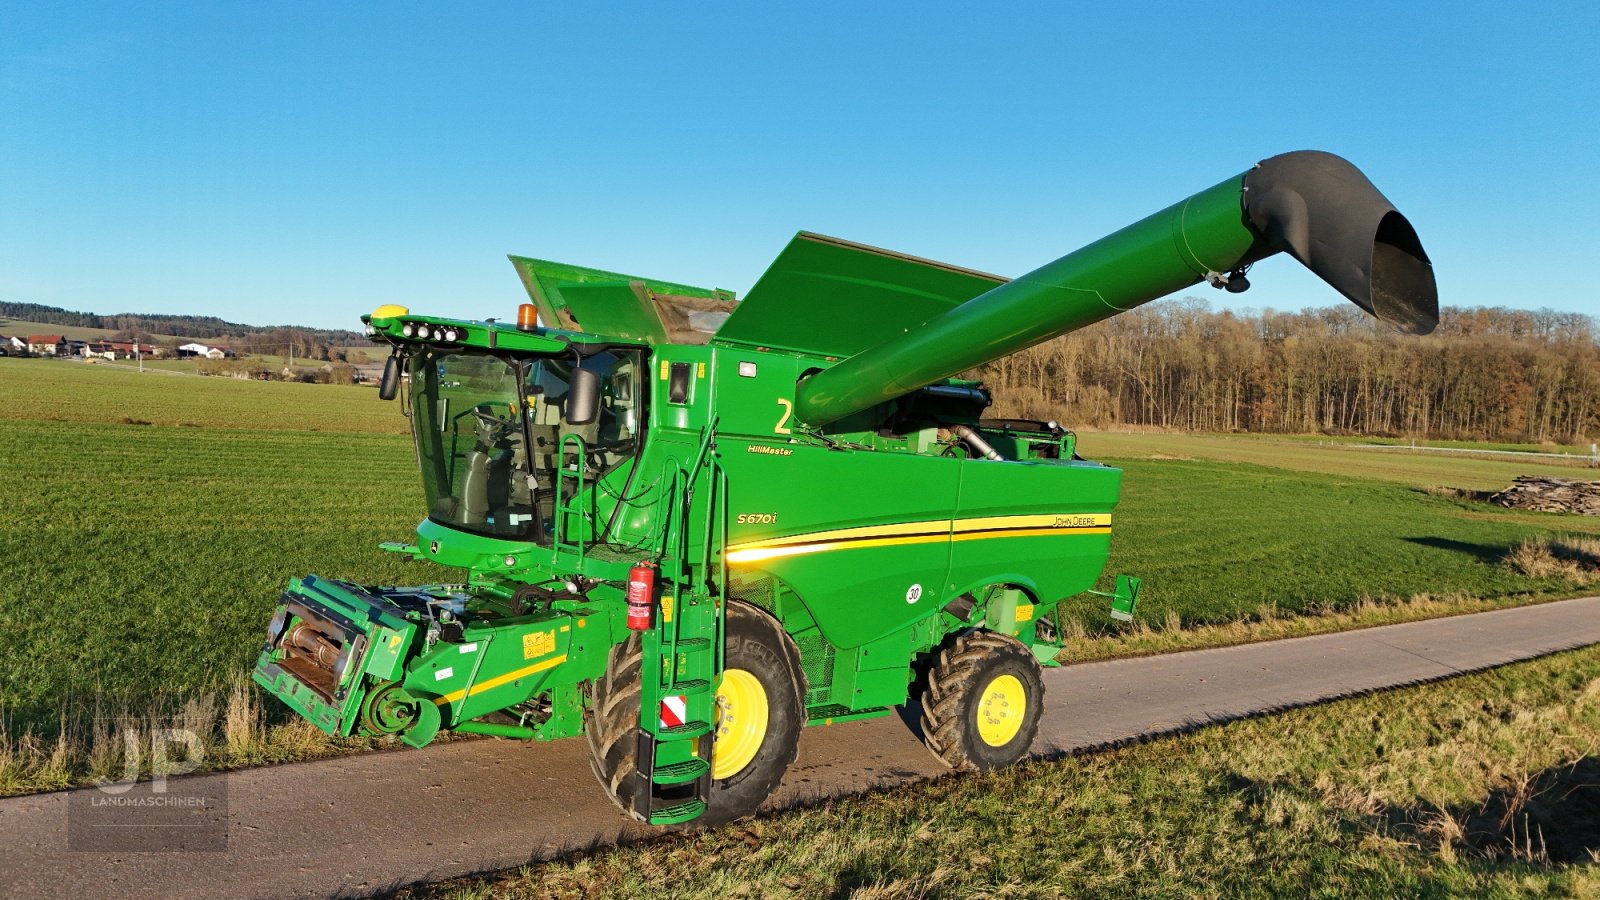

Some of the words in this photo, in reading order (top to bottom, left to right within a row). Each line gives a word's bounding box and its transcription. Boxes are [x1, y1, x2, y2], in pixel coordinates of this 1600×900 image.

[774, 398, 792, 435] 2
[747, 444, 793, 456] HillMaster
[1052, 516, 1072, 526] JOHN
[1073, 516, 1095, 526] DEERE
[908, 587, 920, 600] 30
